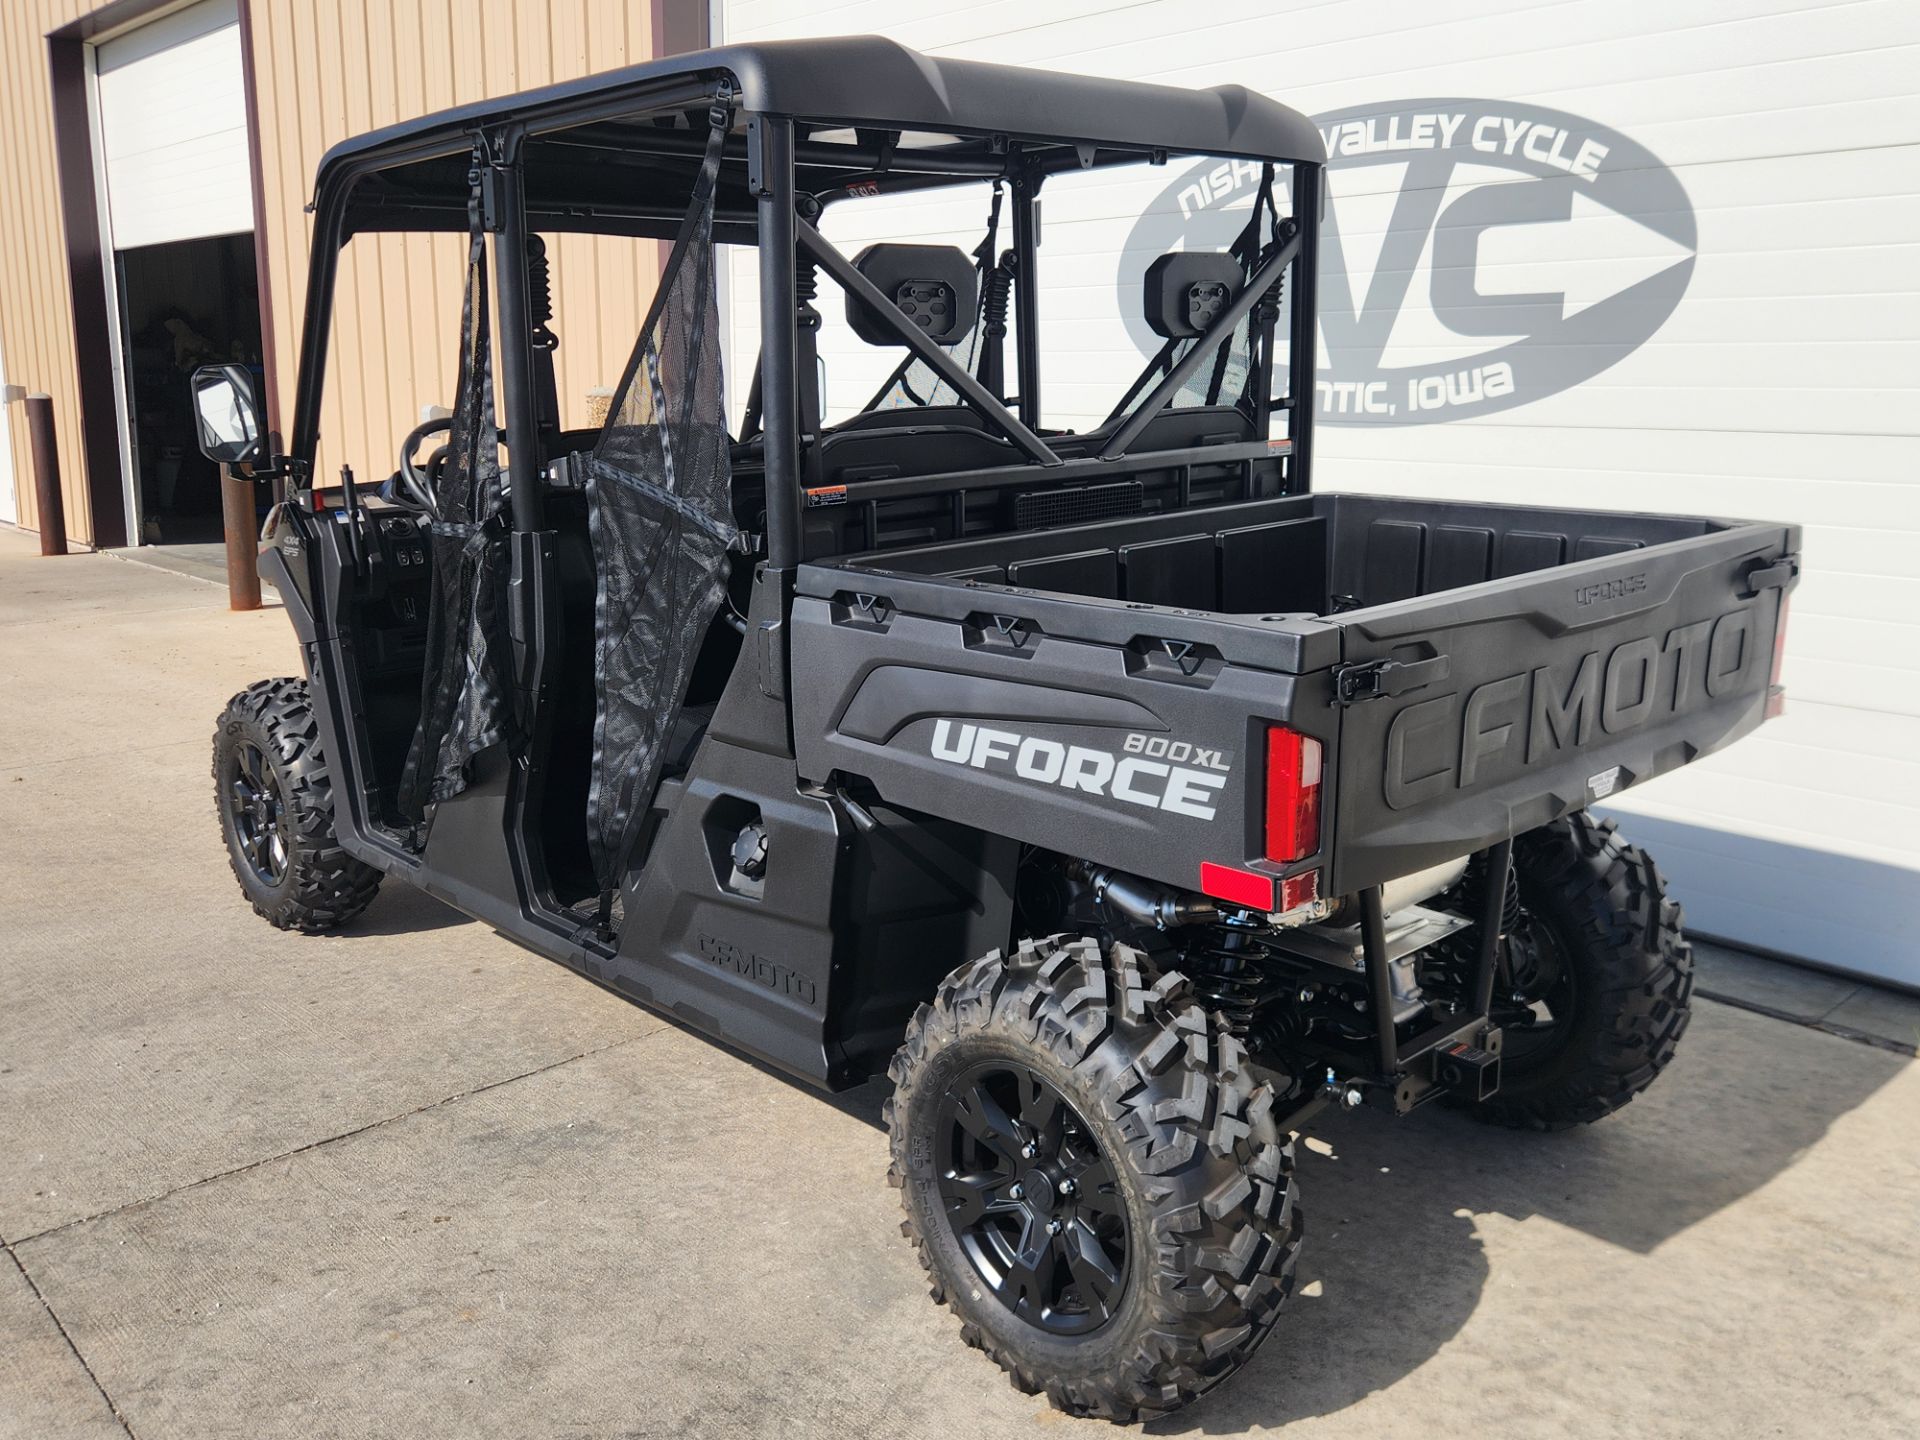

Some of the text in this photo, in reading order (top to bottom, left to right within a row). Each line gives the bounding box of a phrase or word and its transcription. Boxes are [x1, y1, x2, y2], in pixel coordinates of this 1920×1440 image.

[1177, 158, 1294, 220] NISH
[1472, 116, 1609, 183] CYCLE
[1576, 573, 1647, 607] UFORCE
[1384, 608, 1754, 811] CFMOTO
[930, 719, 1227, 821] UFORCE
[697, 932, 816, 1005] CFMOTO
